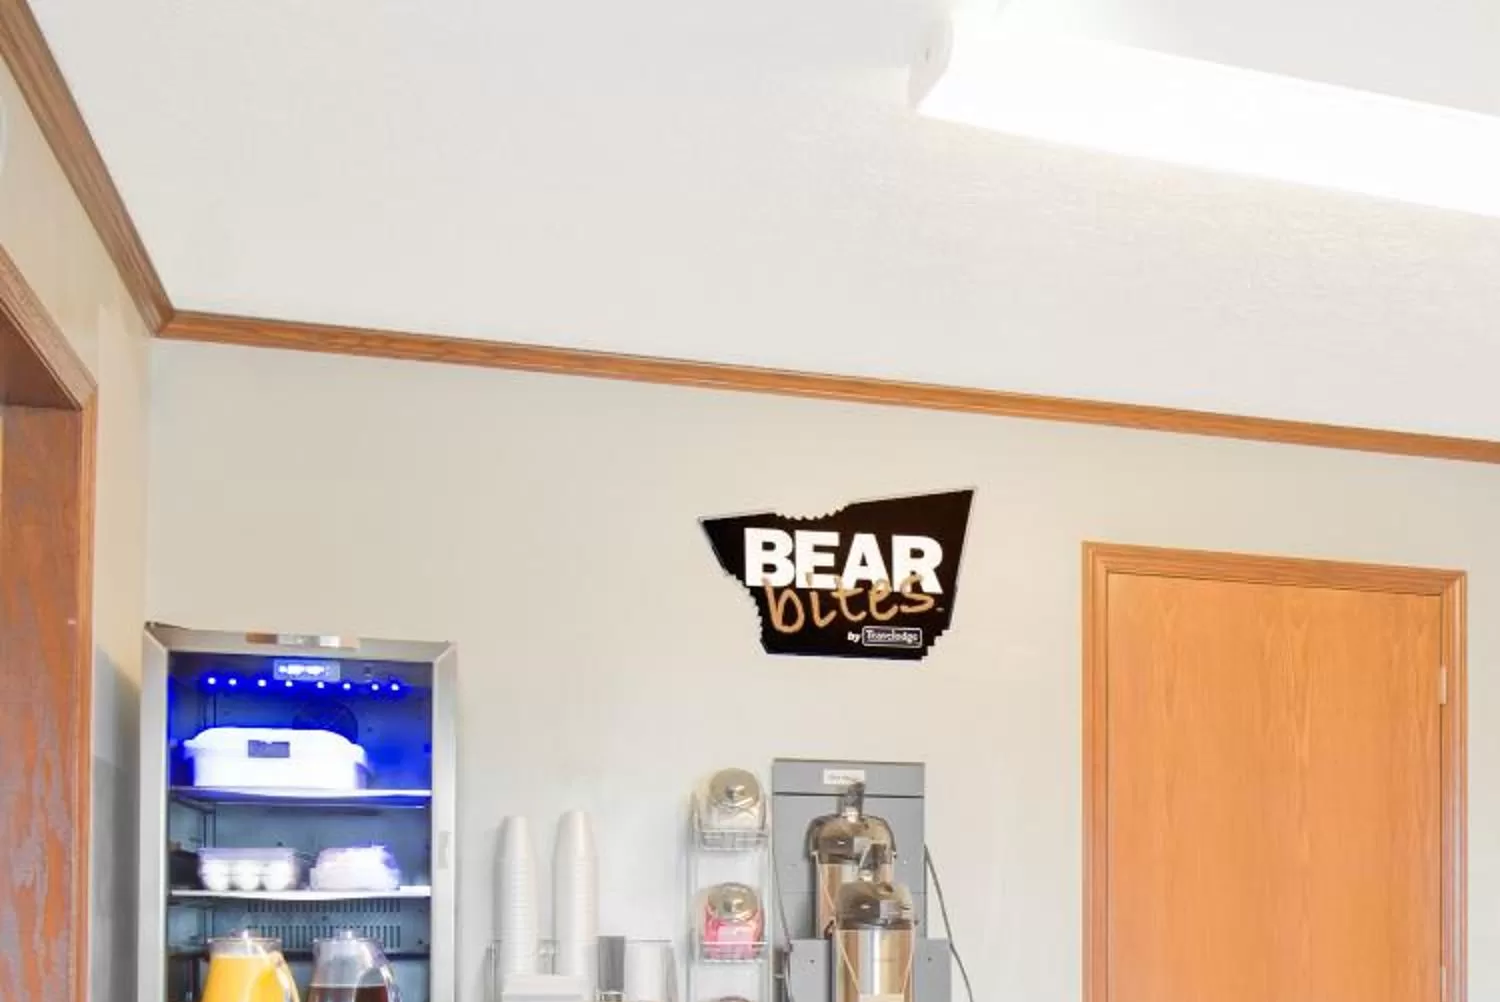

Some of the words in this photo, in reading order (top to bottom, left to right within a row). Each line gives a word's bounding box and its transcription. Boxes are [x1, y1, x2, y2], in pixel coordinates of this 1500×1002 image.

[744, 527, 943, 593] BEAR
[762, 573, 936, 633] bites
[847, 631, 860, 643] by
